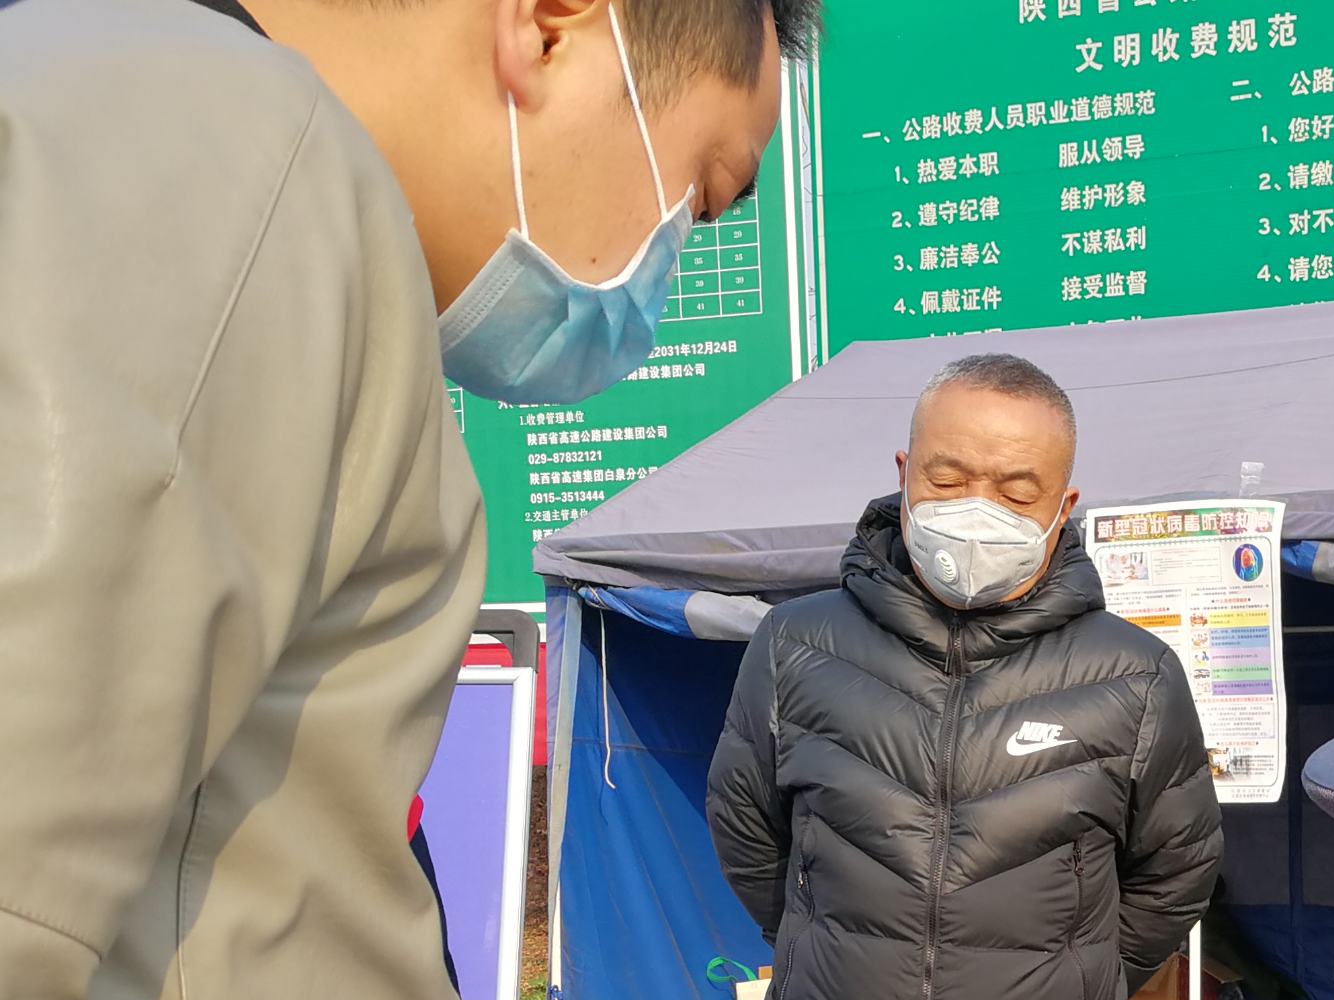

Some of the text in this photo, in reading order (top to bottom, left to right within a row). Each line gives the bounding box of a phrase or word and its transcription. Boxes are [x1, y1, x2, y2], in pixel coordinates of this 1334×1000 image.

[1075, 13, 1298, 72] 文明收费规范
[862, 90, 1157, 143] 一、公路收费人员职业道德规范
[1059, 134, 1145, 168] 服从领导
[1060, 180, 1146, 212] 维护形象
[1061, 226, 1146, 257] 不谋私利
[1061, 270, 1147, 301] 接受监督
[527, 425, 668, 447] 陕西省高速公路建设集团公司
[528, 450, 603, 465] 029-87832121
[530, 490, 605, 504] 0915-3513444
[1017, 721, 1064, 742] NIKE
